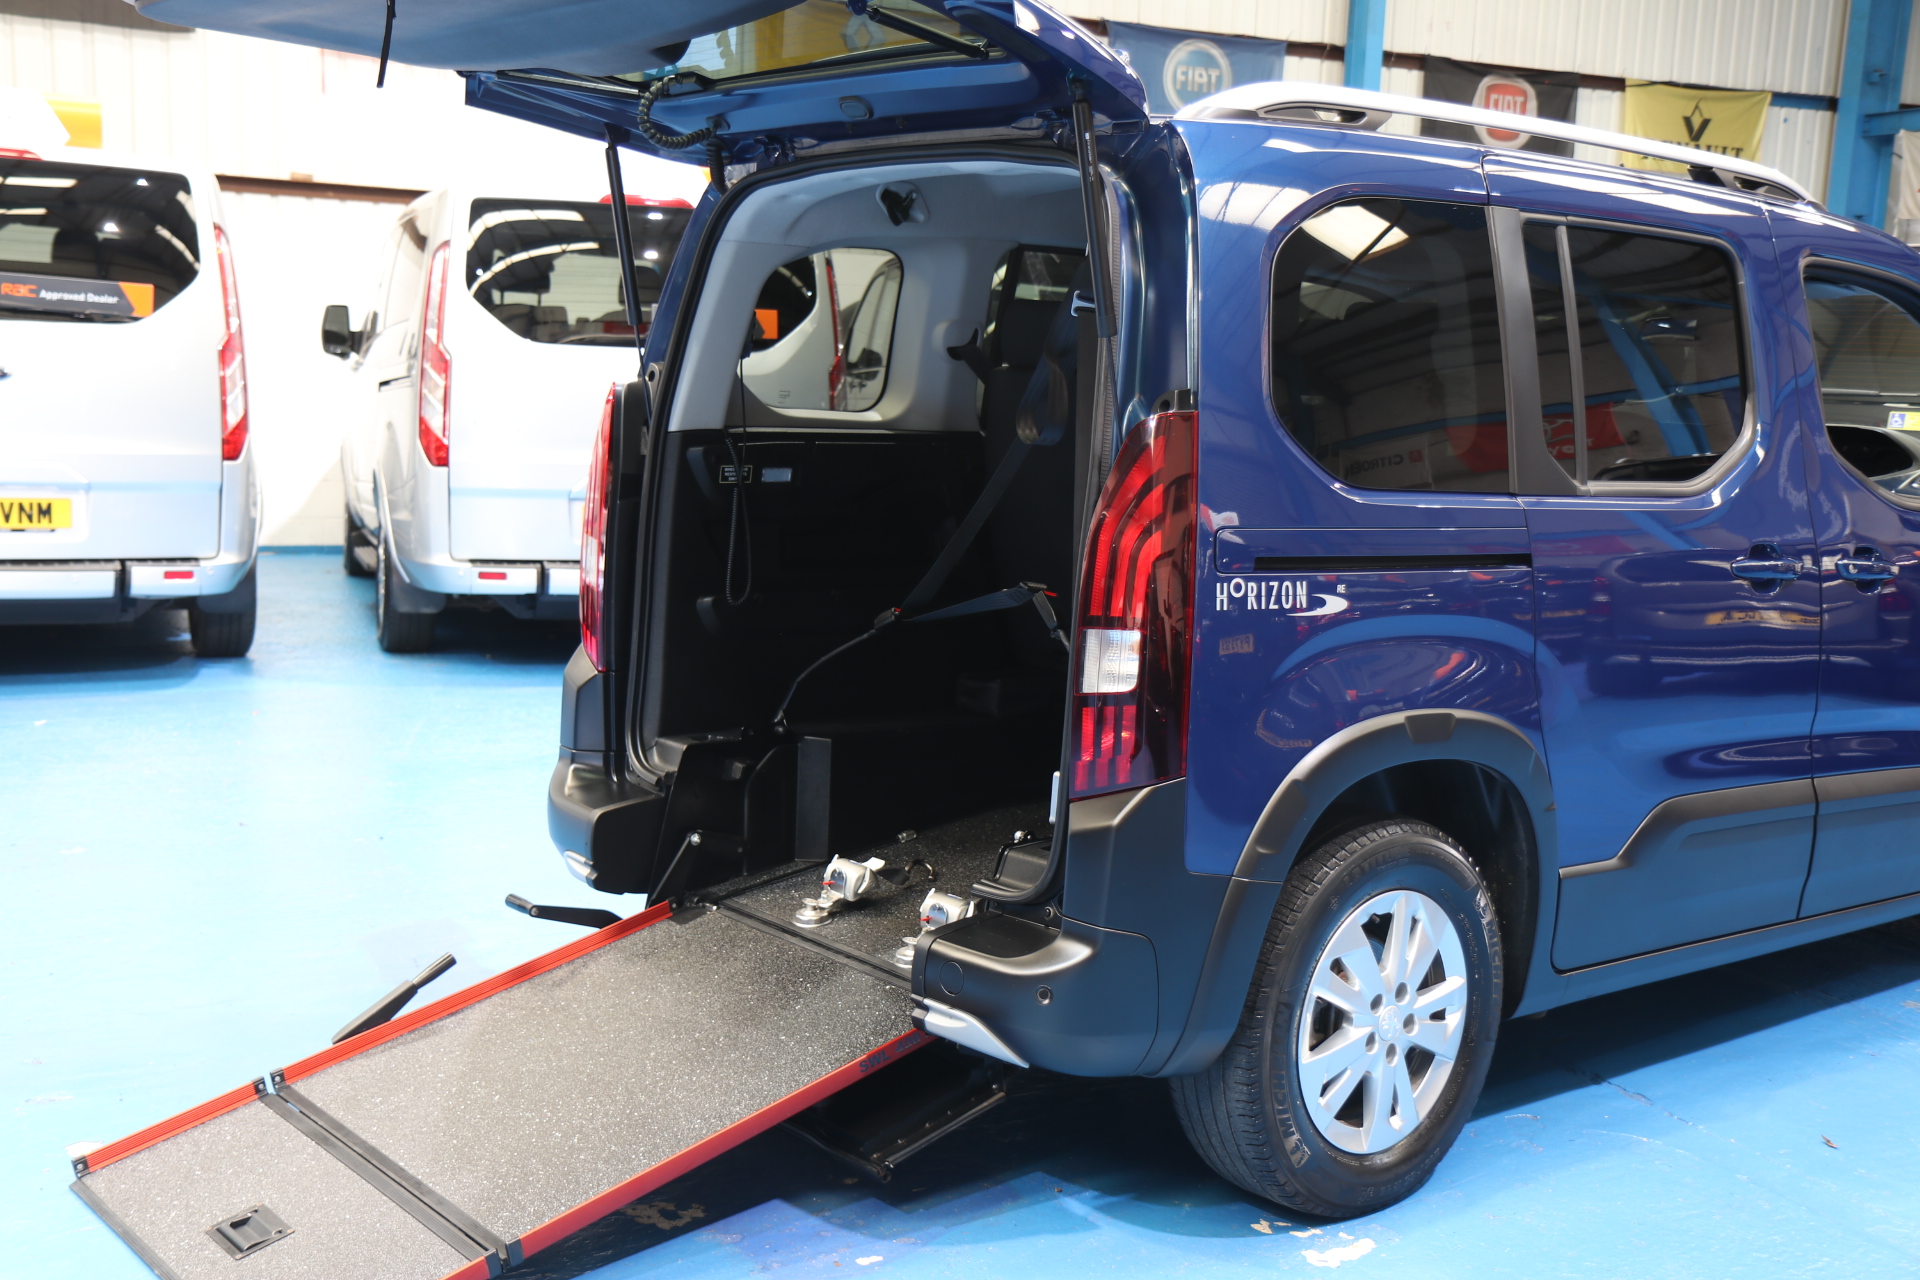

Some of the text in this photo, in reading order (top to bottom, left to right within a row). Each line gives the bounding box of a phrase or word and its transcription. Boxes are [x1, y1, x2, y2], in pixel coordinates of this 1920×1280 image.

[1176, 65, 1220, 93] FIAT
[40, 288, 86, 301] Approved
[86, 292, 120, 304] Dealer
[0, 502, 52, 524] VNM
[1337, 584, 1346, 593] RE
[859, 1032, 921, 1073] SWL 400
